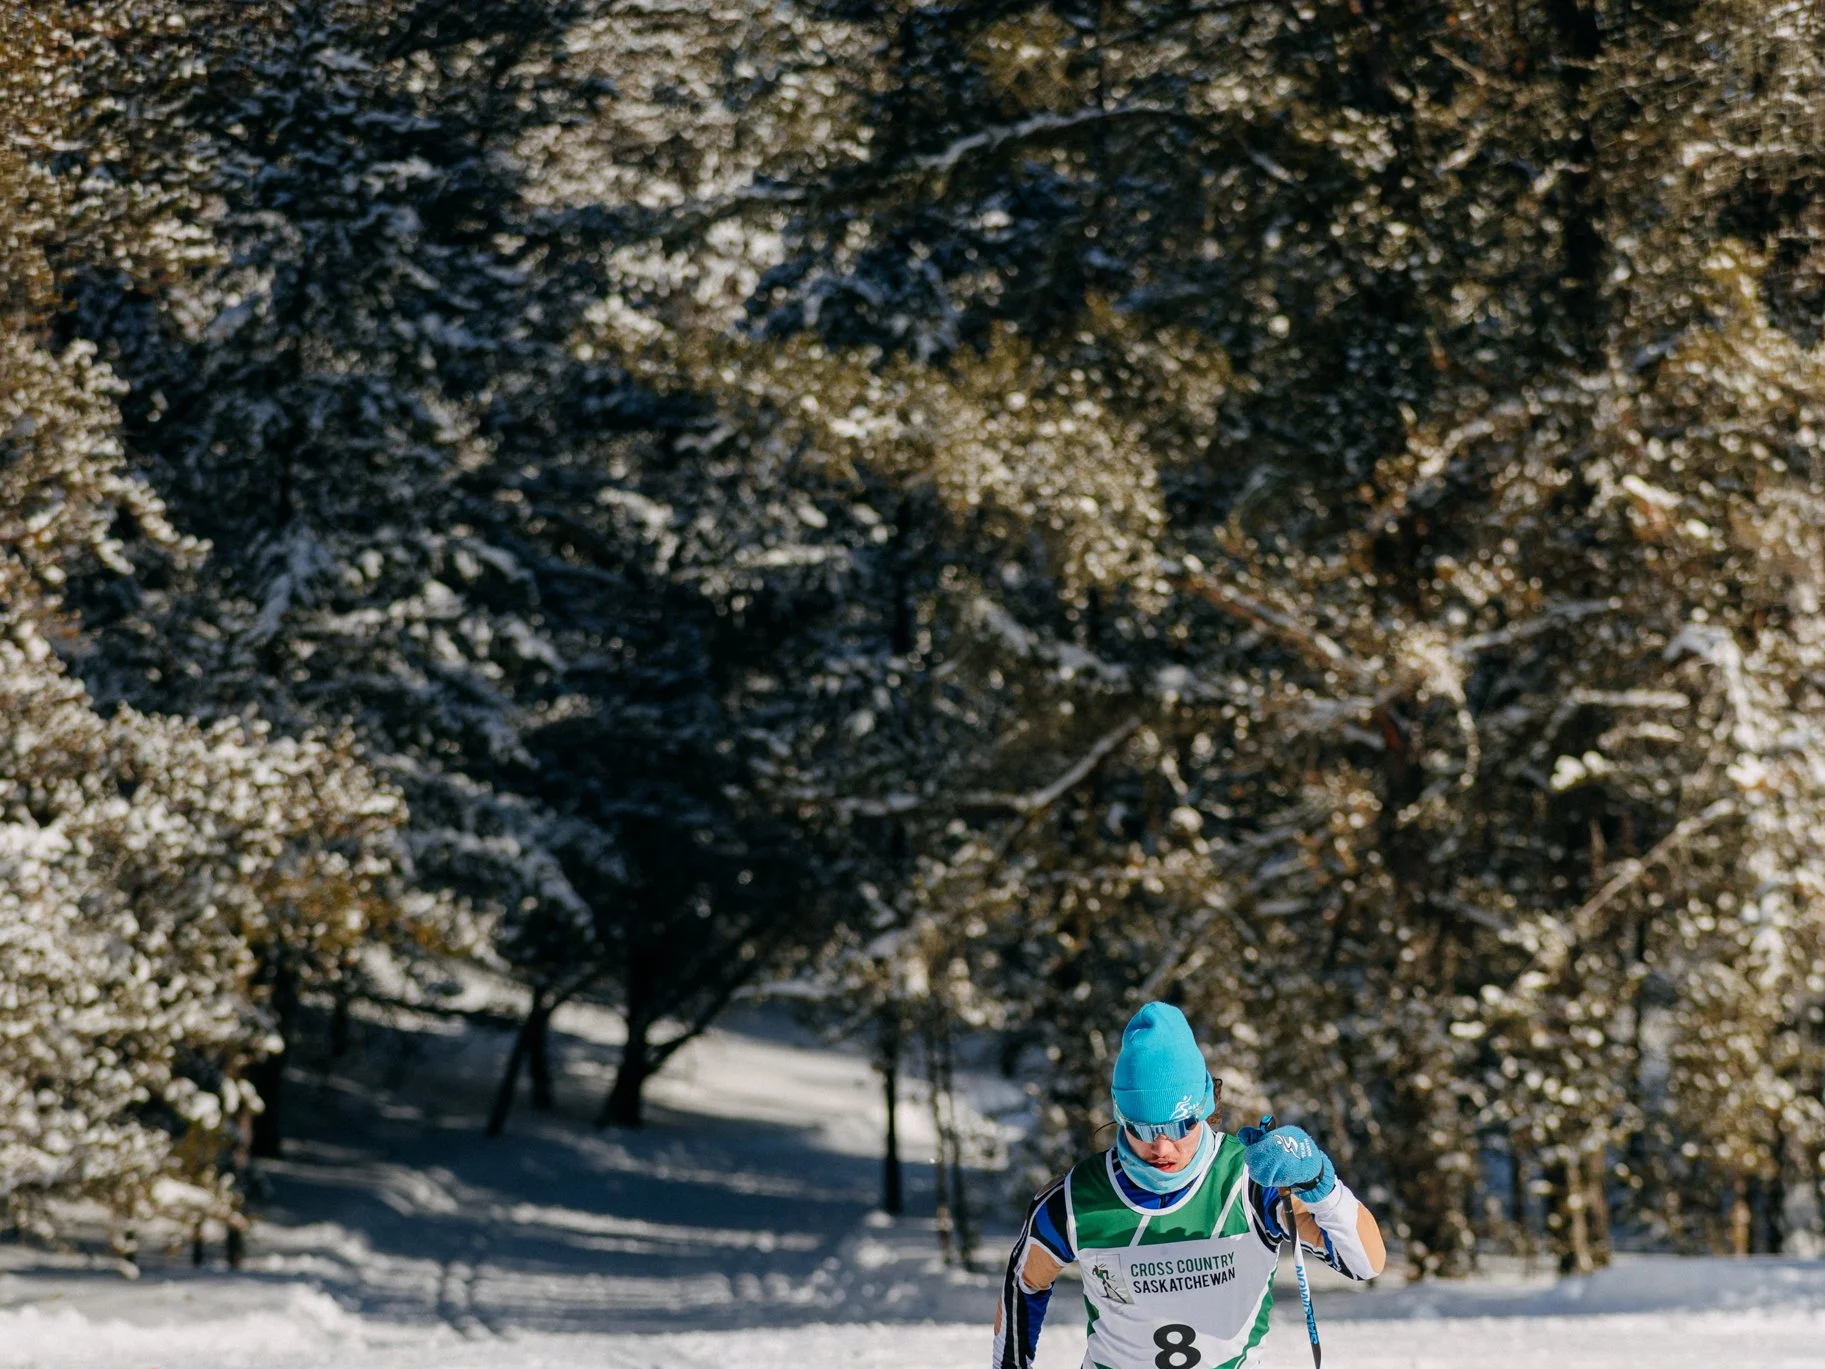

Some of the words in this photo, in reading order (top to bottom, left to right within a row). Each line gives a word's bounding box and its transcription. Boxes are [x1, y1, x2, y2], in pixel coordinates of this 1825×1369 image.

[1130, 1261, 1174, 1278] CROSS
[1177, 1251, 1236, 1275] COUNTRY
[1133, 1267, 1236, 1294] SASKATCHEWAN
